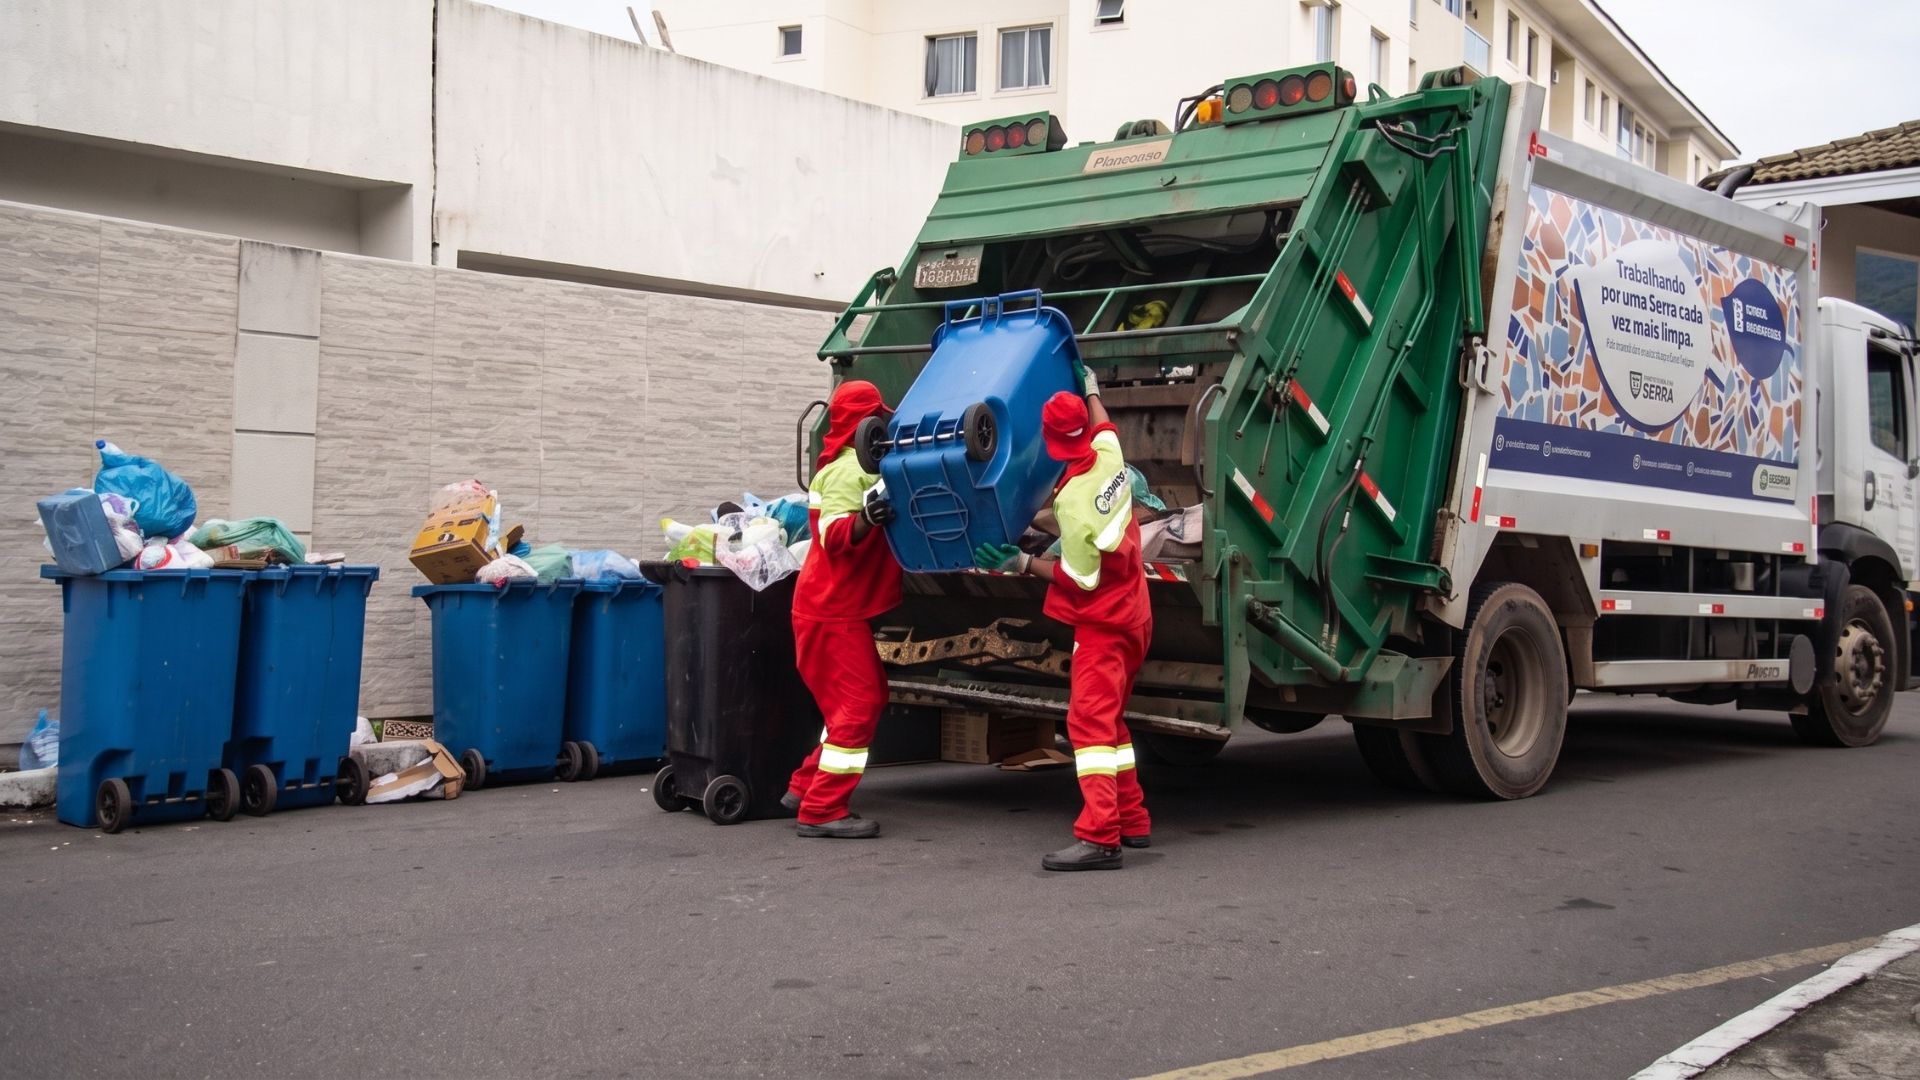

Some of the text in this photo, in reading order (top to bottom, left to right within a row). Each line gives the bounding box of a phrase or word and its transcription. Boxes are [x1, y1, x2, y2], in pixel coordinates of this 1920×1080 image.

[1616, 259, 1686, 295] Trabalhando
[1601, 285, 1703, 324] por uma Serra cada
[1611, 314, 1694, 350] vez mais limpa.
[1642, 382, 1674, 404] SERRA
